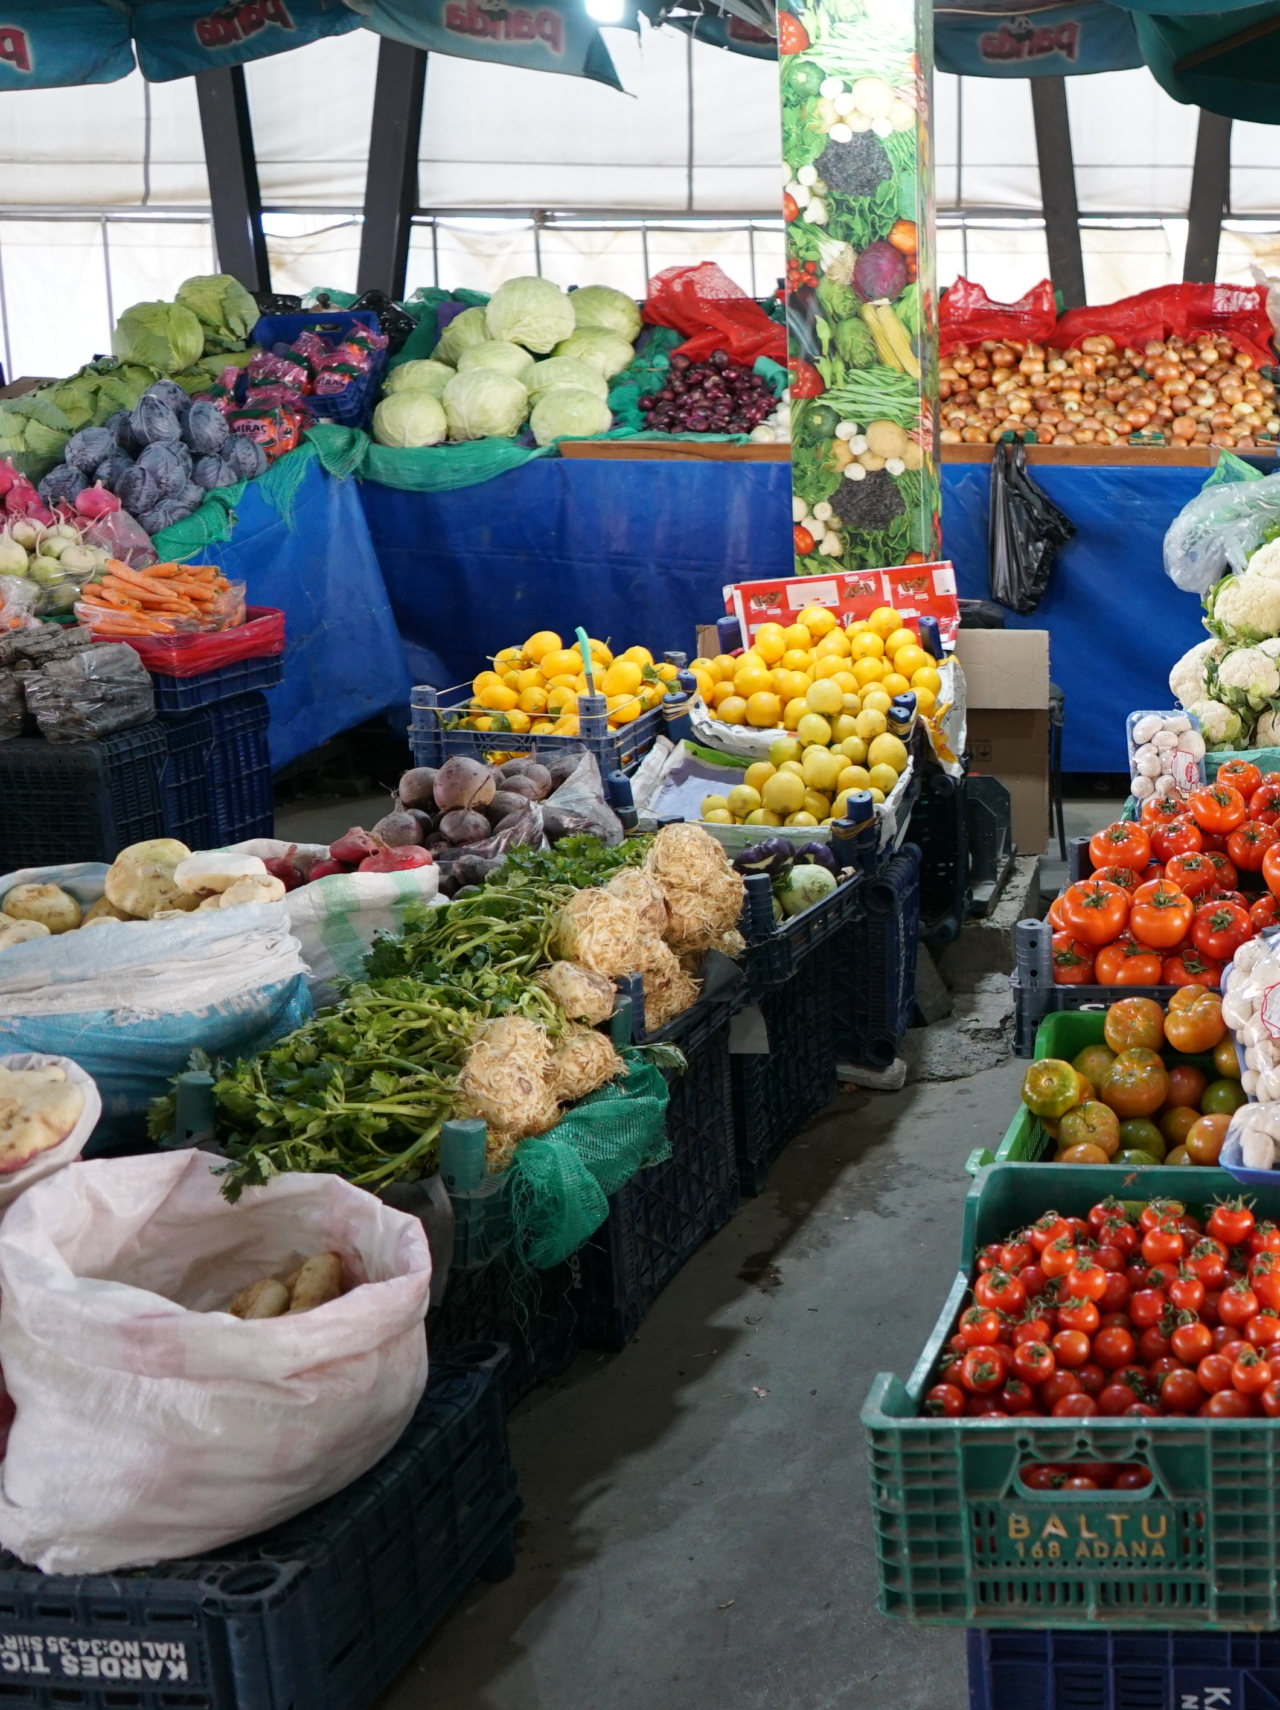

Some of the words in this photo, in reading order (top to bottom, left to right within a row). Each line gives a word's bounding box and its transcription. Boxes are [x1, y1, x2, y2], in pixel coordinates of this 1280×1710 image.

[1007, 1512, 1168, 1539] BALTU
[1014, 1540, 1061, 1559] 168
[1075, 1540, 1166, 1559] ADANA
[141, 1641, 185, 1660] HAL
